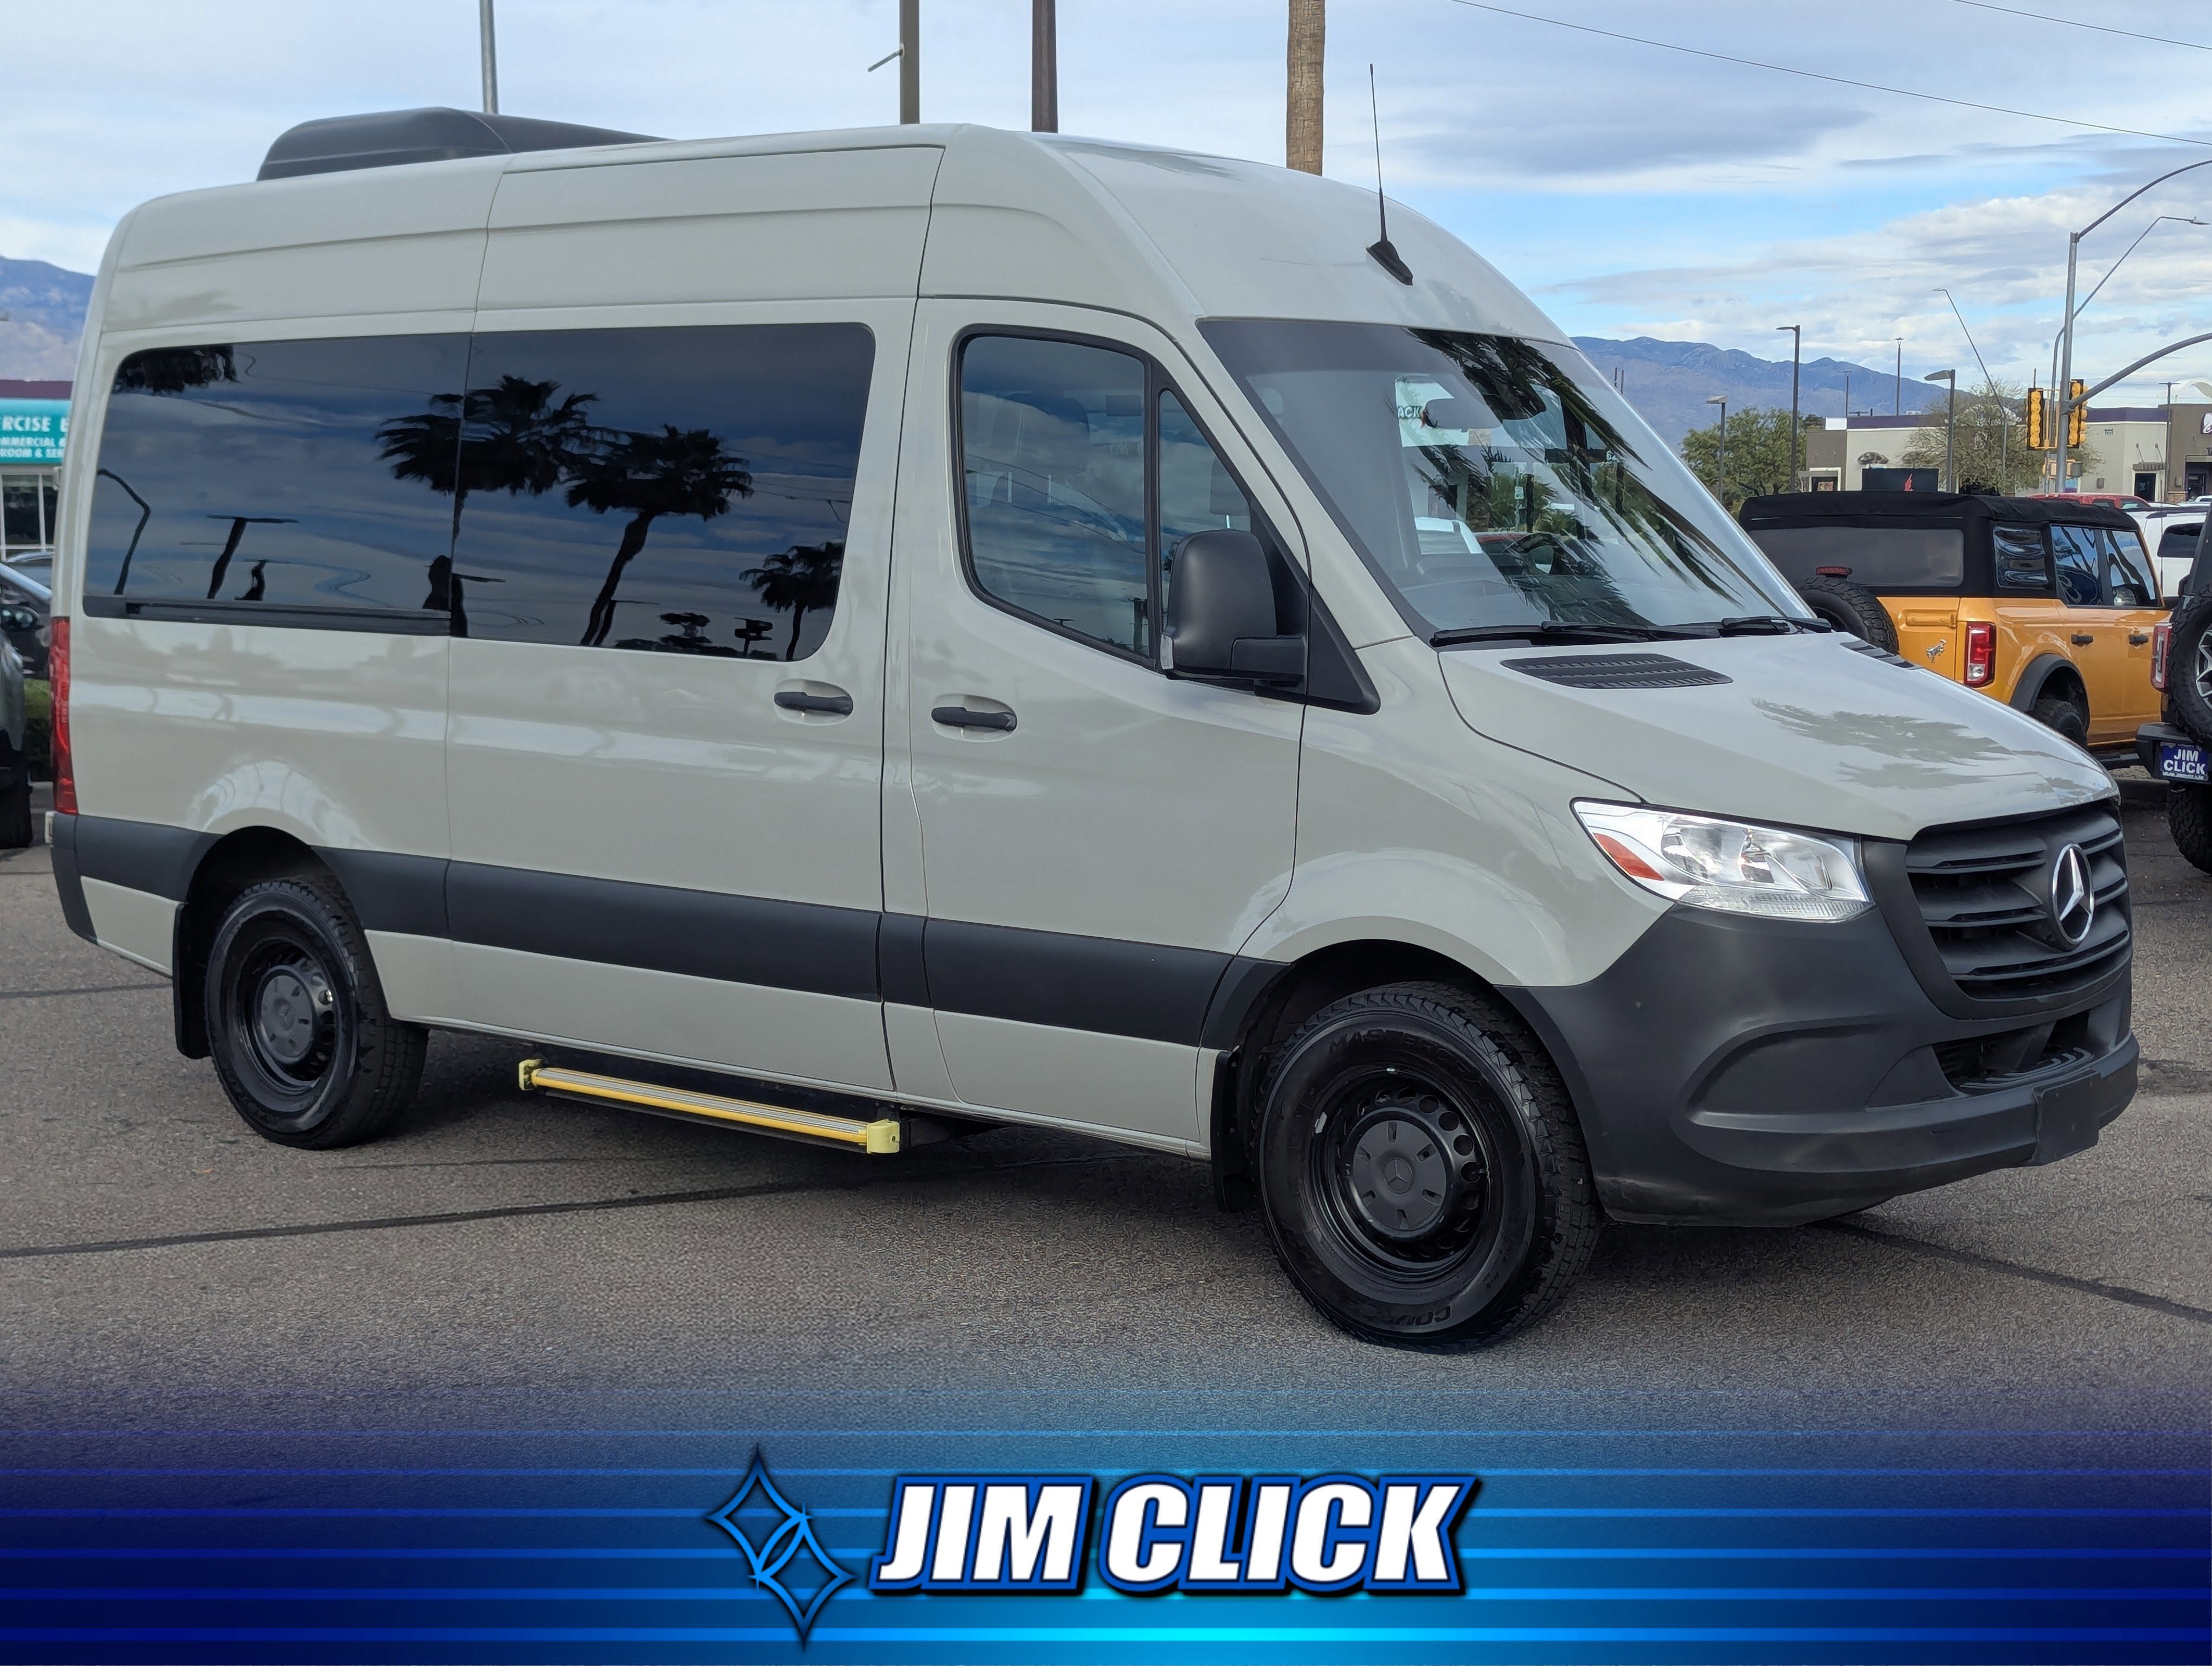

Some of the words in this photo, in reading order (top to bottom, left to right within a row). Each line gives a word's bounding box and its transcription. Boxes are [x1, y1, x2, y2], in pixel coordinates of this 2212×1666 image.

[0, 416, 52, 432] RCISE
[2174, 749, 2198, 762] JIM
[2164, 759, 2205, 776] CLICK
